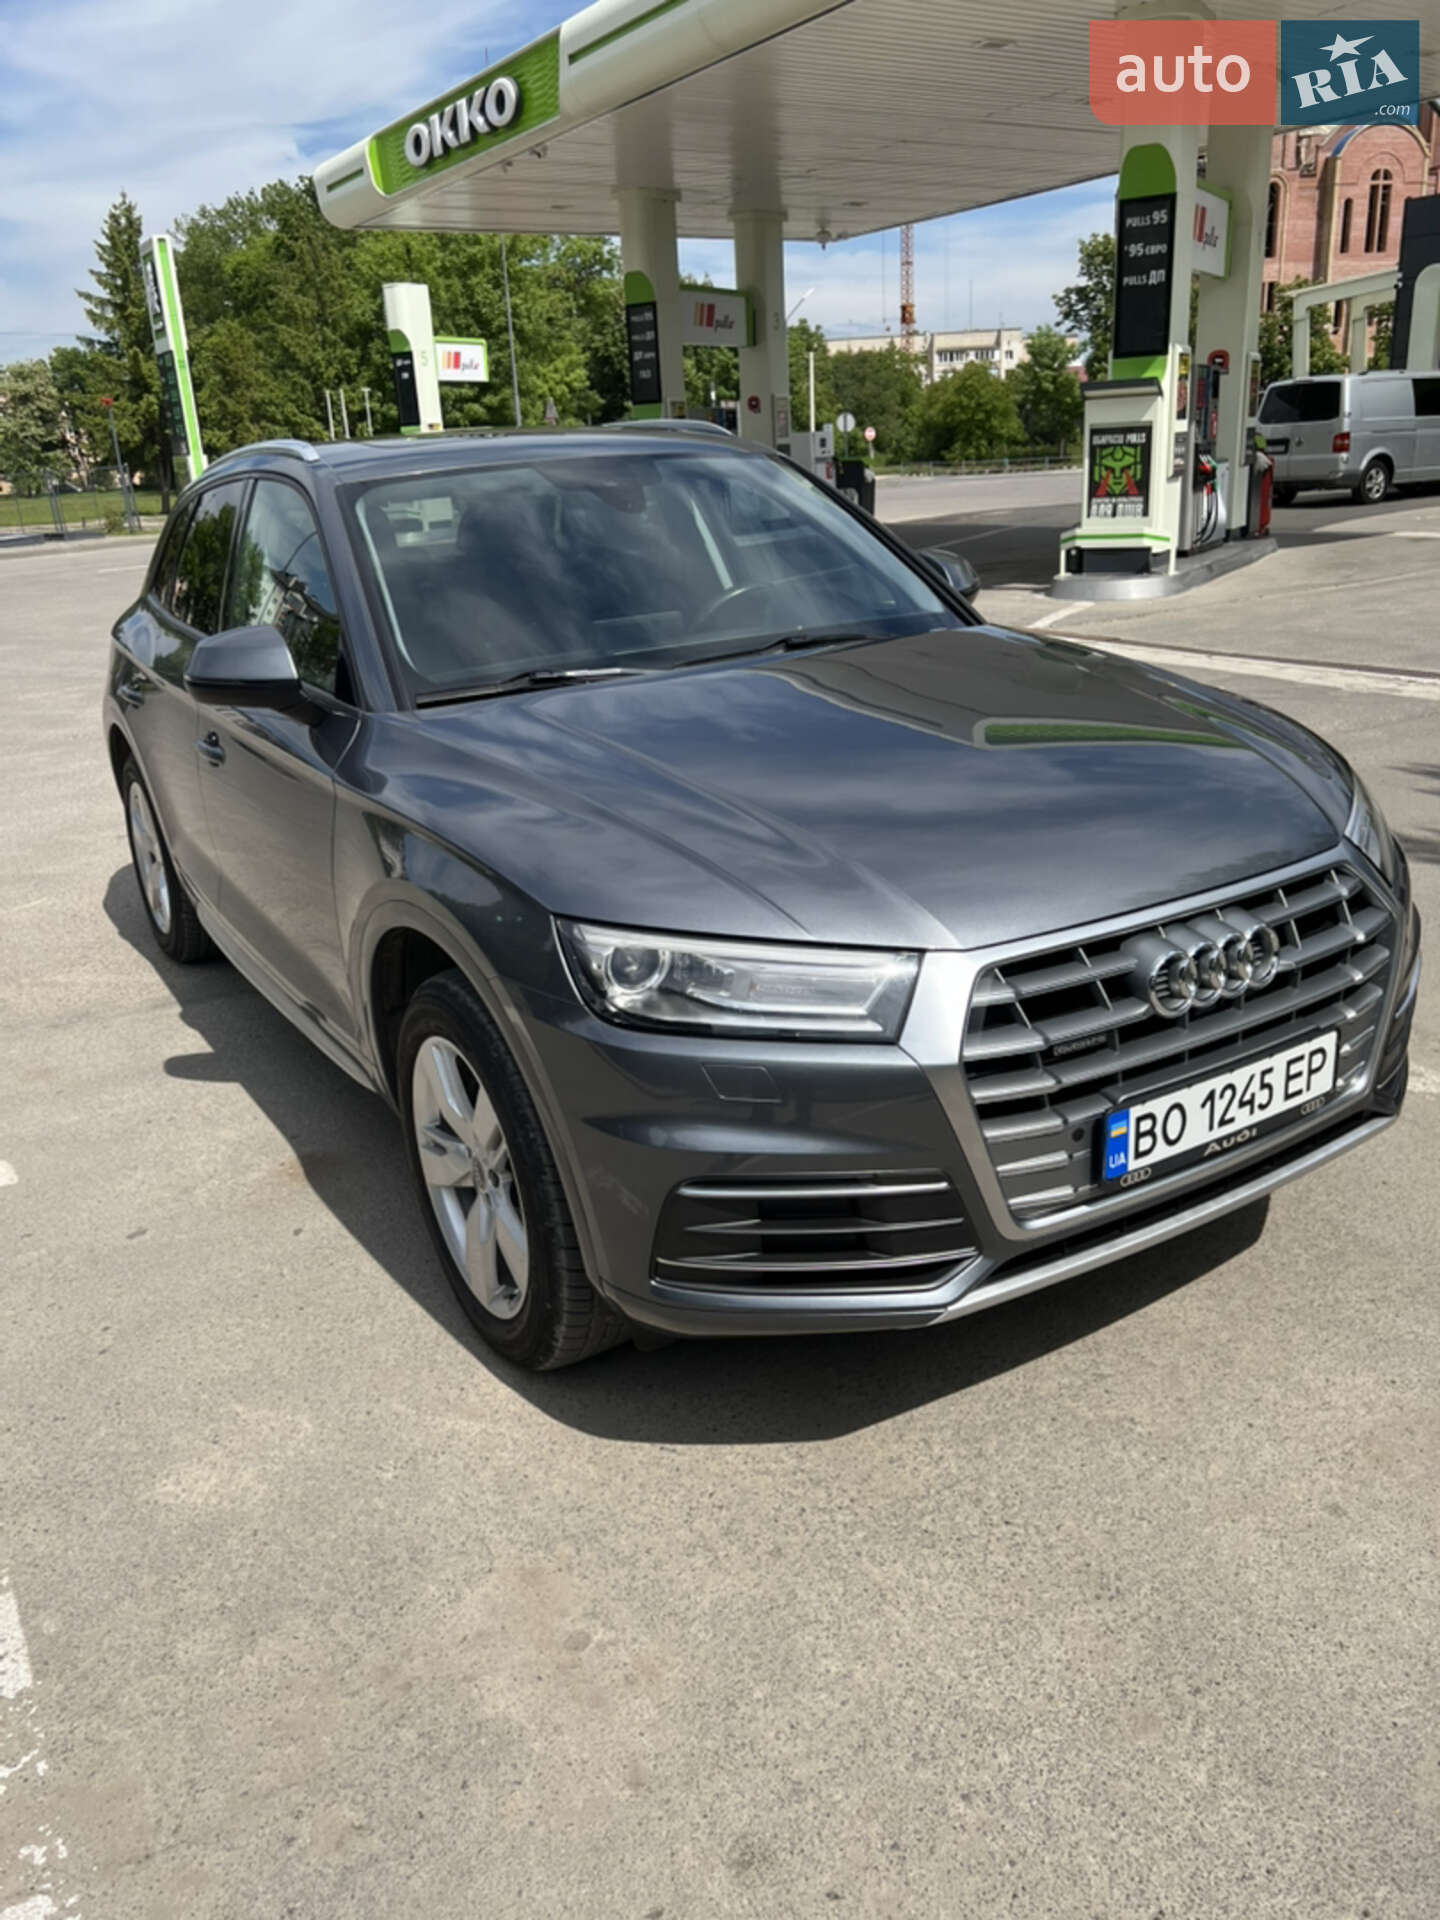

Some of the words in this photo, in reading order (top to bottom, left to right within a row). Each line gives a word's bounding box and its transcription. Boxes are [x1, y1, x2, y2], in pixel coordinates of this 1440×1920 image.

[404, 76, 518, 167] OKKO
[1126, 214, 1151, 229] PULLS
[1152, 209, 1168, 225] 95
[1123, 274, 1147, 287] PULLS
[1134, 1102, 1187, 1160] BO
[1201, 1067, 1274, 1132] 1245
[1283, 1046, 1327, 1101] EP
[1108, 1153, 1126, 1168] UA
